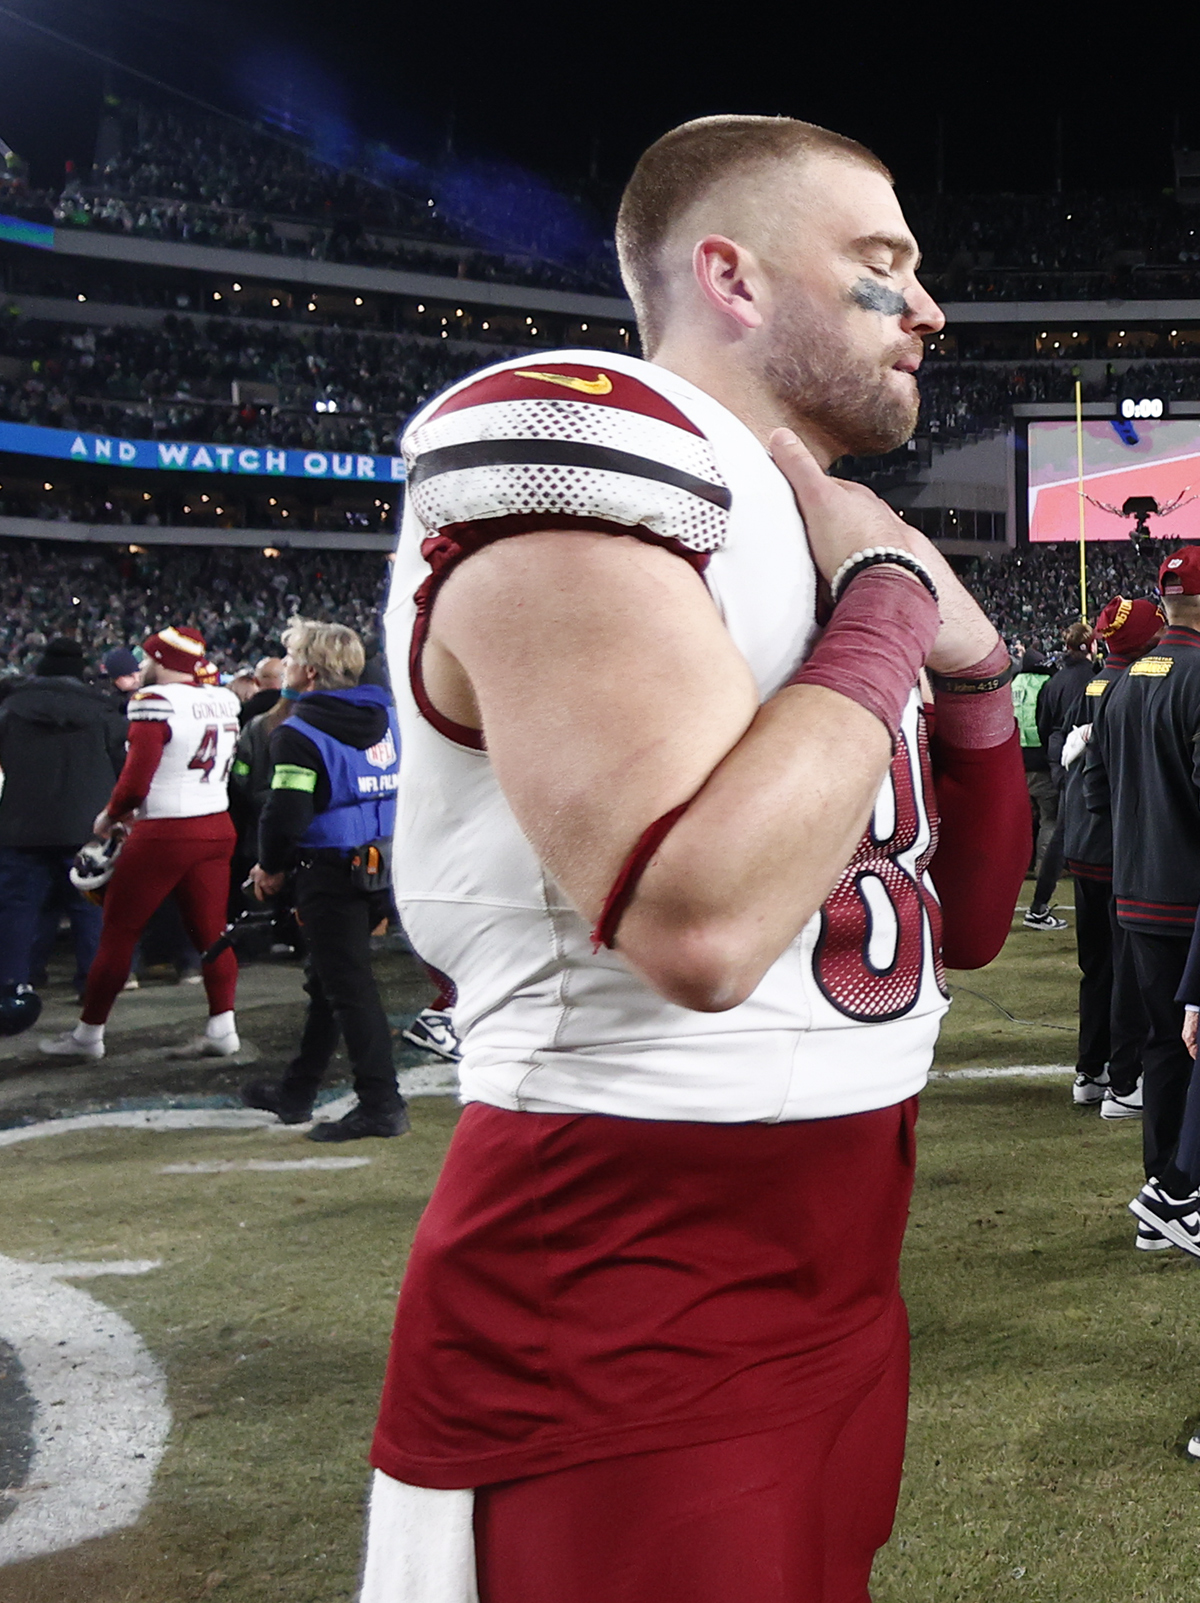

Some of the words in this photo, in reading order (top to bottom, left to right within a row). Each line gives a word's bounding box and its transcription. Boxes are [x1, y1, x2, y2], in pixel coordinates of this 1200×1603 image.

[1121, 399, 1164, 418] 0:00
[70, 436, 136, 461] AND
[157, 444, 287, 473] WATCH
[303, 452, 376, 478] OUR
[977, 680, 999, 690] 4:19
[192, 702, 239, 720] GONZALE
[358, 776, 379, 793] NFL
